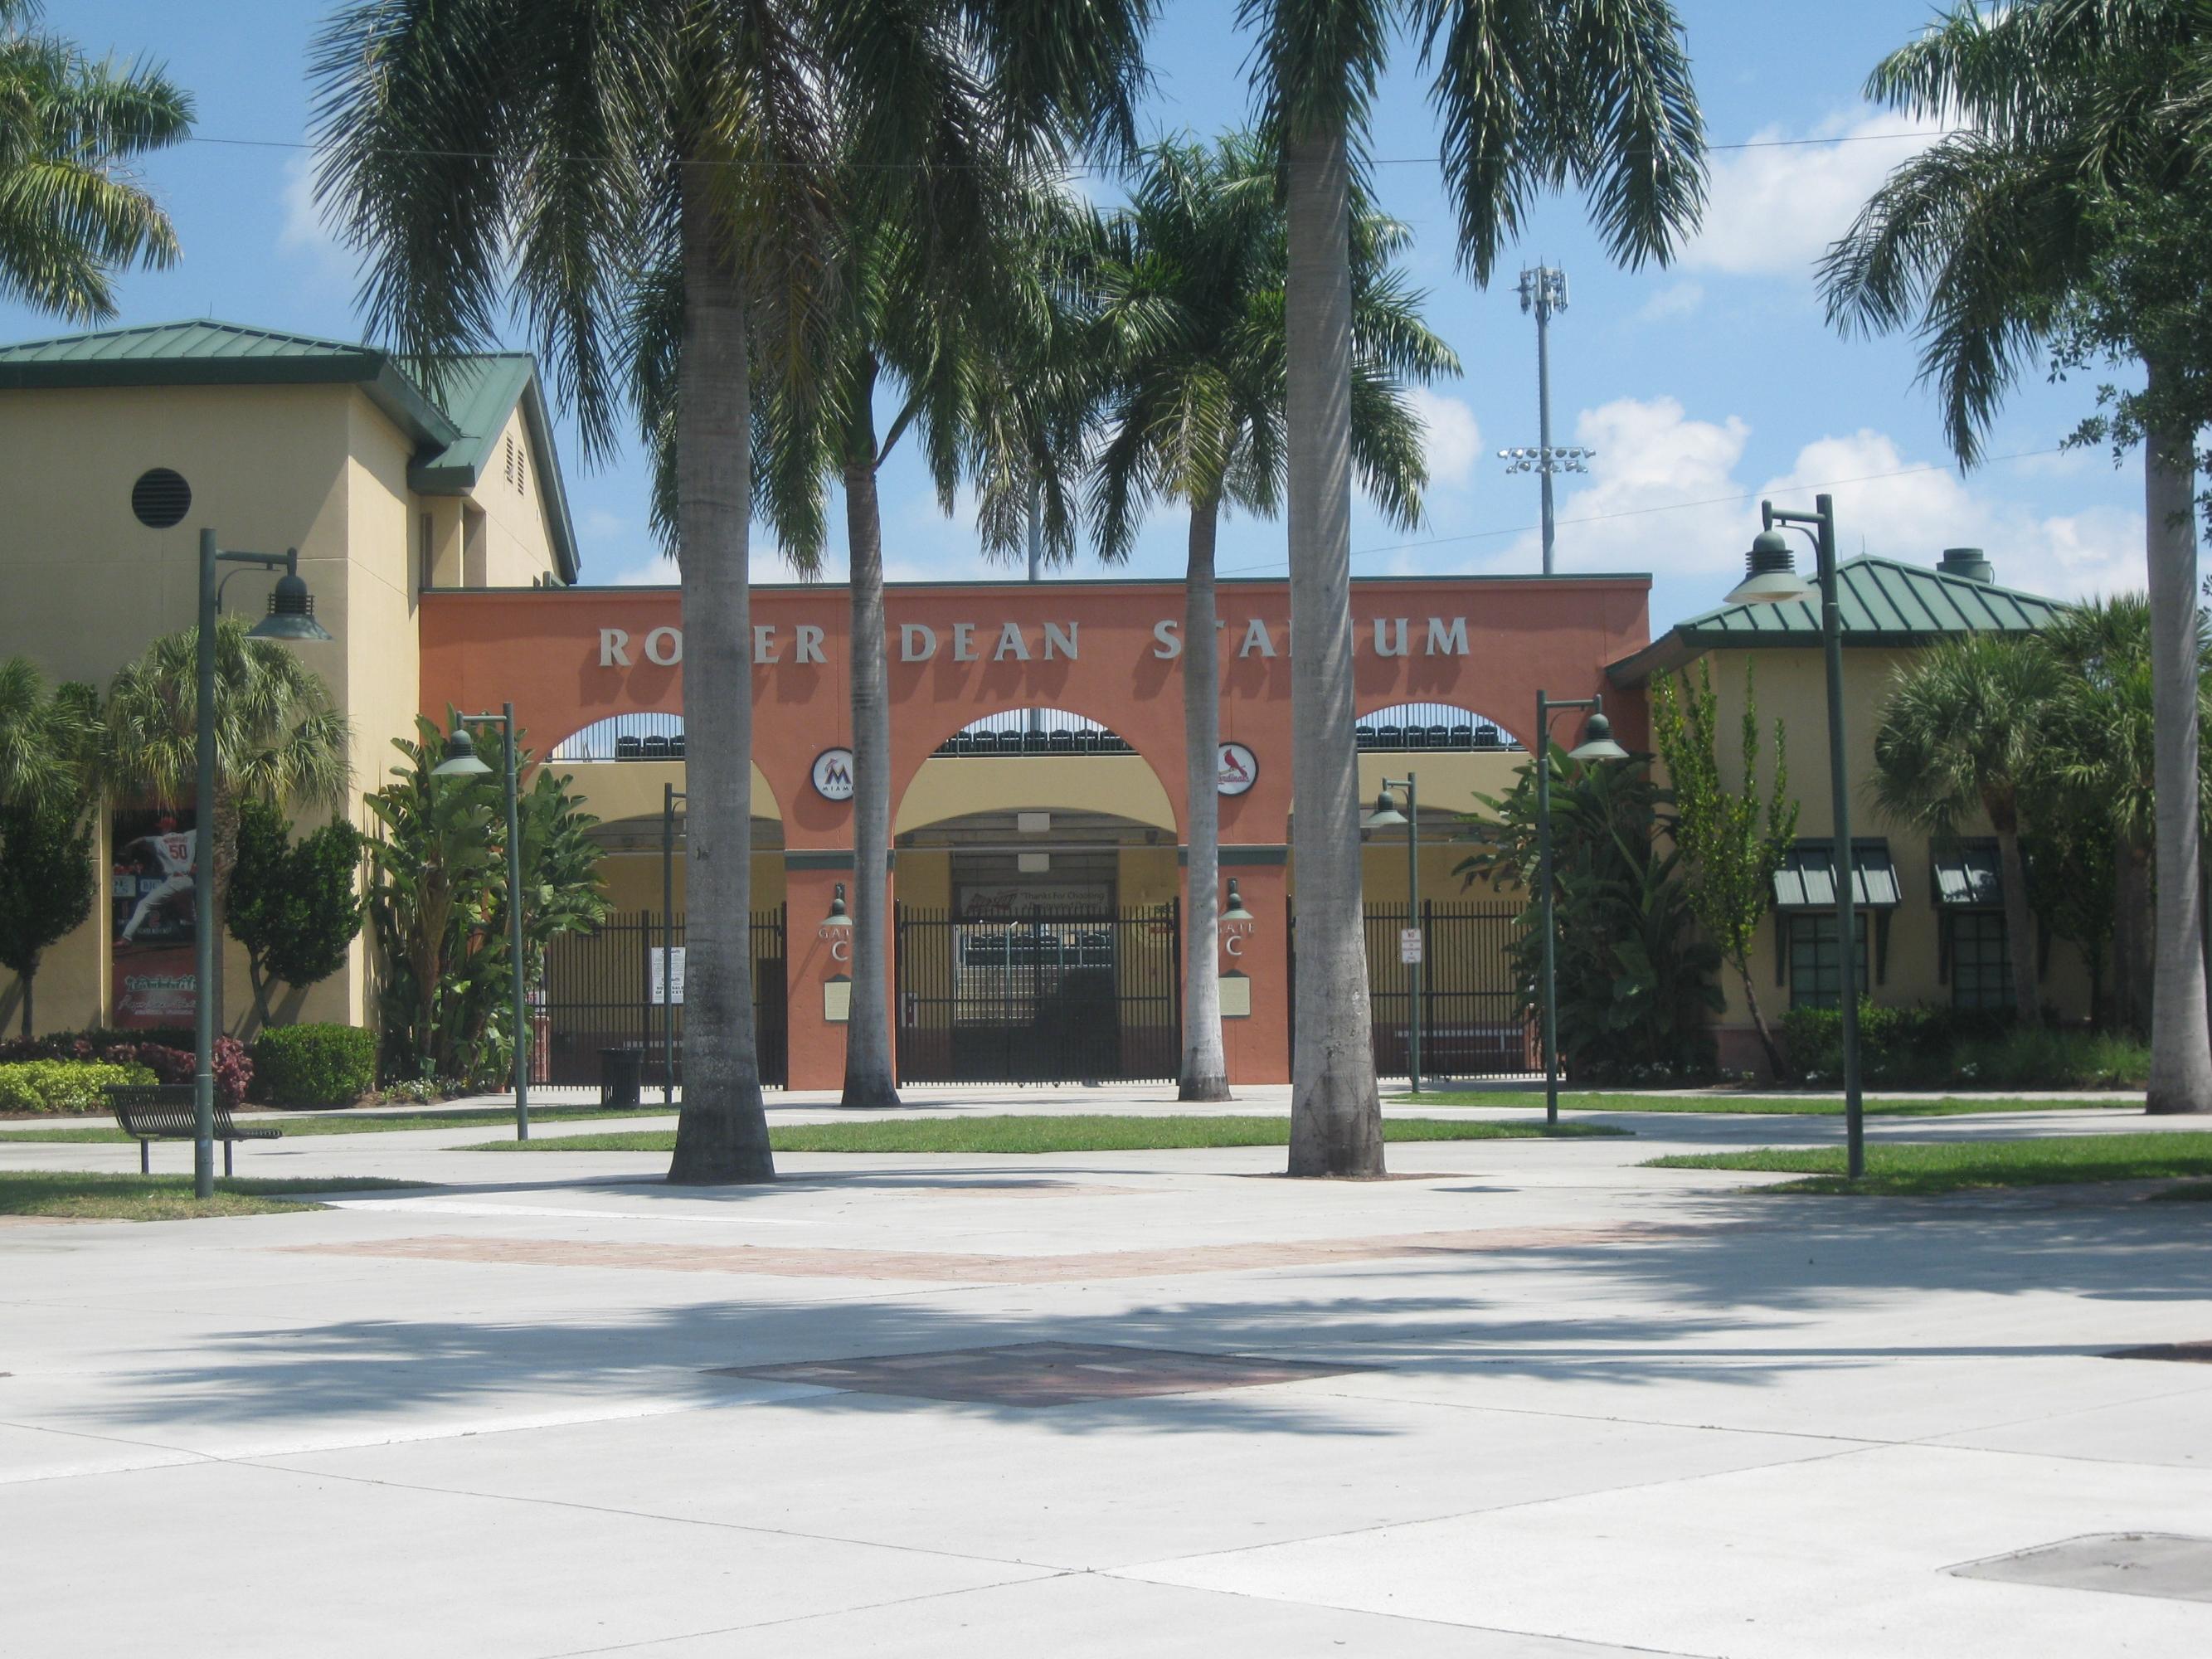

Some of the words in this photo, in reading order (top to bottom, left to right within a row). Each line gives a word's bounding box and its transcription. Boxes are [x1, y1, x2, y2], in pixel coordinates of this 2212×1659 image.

[598, 624, 829, 666] ROER
[900, 621, 1078, 662] DEAN
[1153, 616, 1471, 659] SAUM
[168, 844, 187, 860] 50
[818, 928, 850, 939] GAT
[832, 941, 848, 961] C
[1226, 935, 1242, 956] C
